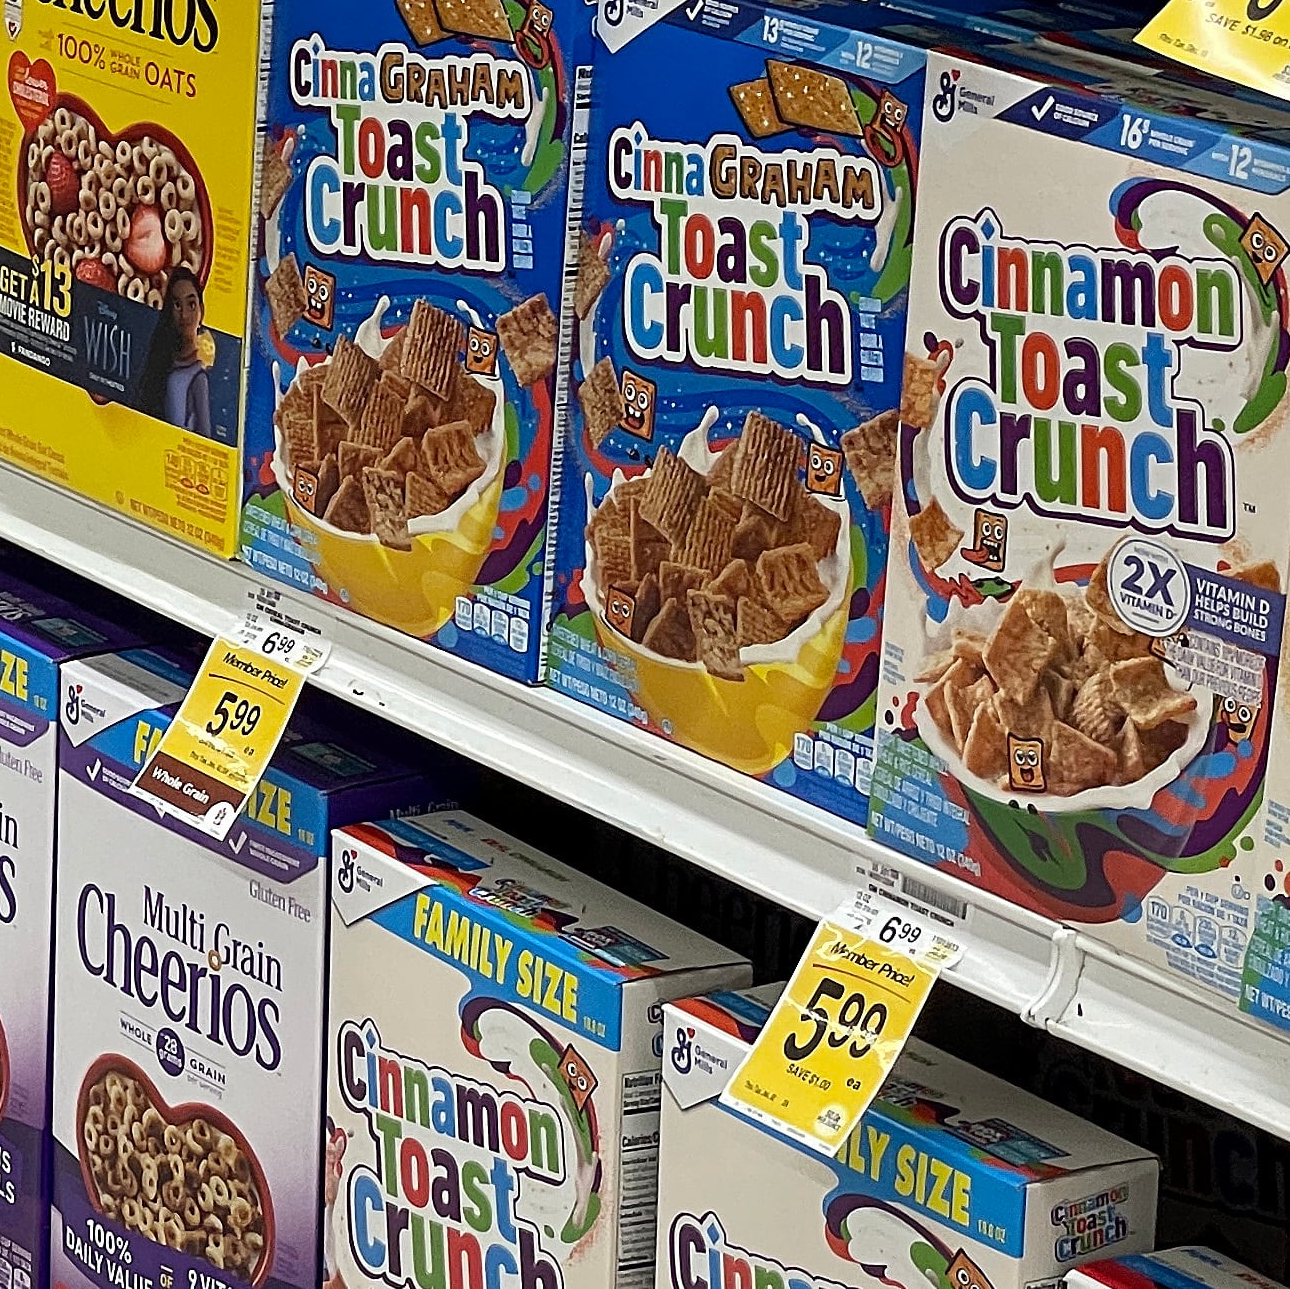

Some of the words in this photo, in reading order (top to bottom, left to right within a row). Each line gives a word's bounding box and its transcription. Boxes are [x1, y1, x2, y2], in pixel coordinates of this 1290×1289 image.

[1205, 12, 1238, 32] SAVE
[57, 33, 106, 71] 100%
[145, 60, 197, 98] OATS
[293, 39, 524, 109] CinnaGRAHAM
[334, 104, 464, 187] Toast
[612, 122, 875, 210] CinnaGRAHAM
[307, 163, 500, 264] Crunch
[659, 200, 807, 287] Toast
[946, 218, 1236, 338] Cinnamon
[28, 307, 70, 343] REWARD
[83, 314, 132, 381] WISH
[624, 260, 849, 375] Crunch
[989, 311, 1174, 428] Toast
[953, 387, 1227, 525] Crunch
[1121, 555, 1177, 607] 2X
[1195, 595, 1230, 616] HELPS
[1232, 610, 1268, 628] BUILD
[1196, 578, 1255, 610] VITAMIN
[1259, 600, 1270, 614] D
[223, 649, 253, 679] Member
[252, 664, 288, 692] Price!
[261, 631, 295, 659] 699
[205, 691, 262, 739] 599
[143, 885, 206, 955] Multi
[212, 921, 282, 992] Grain
[249, 879, 278, 906] Gluten
[280, 893, 311, 924] Free
[879, 916, 922, 944] 699
[77, 883, 281, 1072] Cheerios
[412, 892, 513, 988] FAMILY
[517, 947, 579, 1019] SIZE
[830, 941, 880, 972] Member
[878, 963, 915, 988] Price!
[783, 978, 889, 1061] 599
[339, 1023, 561, 1176] Cinnamon
[786, 1063, 810, 1083] SAVE
[809, 1073, 831, 1091] $1.00
[846, 1077, 861, 1091] ea
[374, 1109, 515, 1245] Toast
[895, 1149, 973, 1224] SIZE
[353, 1173, 562, 1289] Crunch
